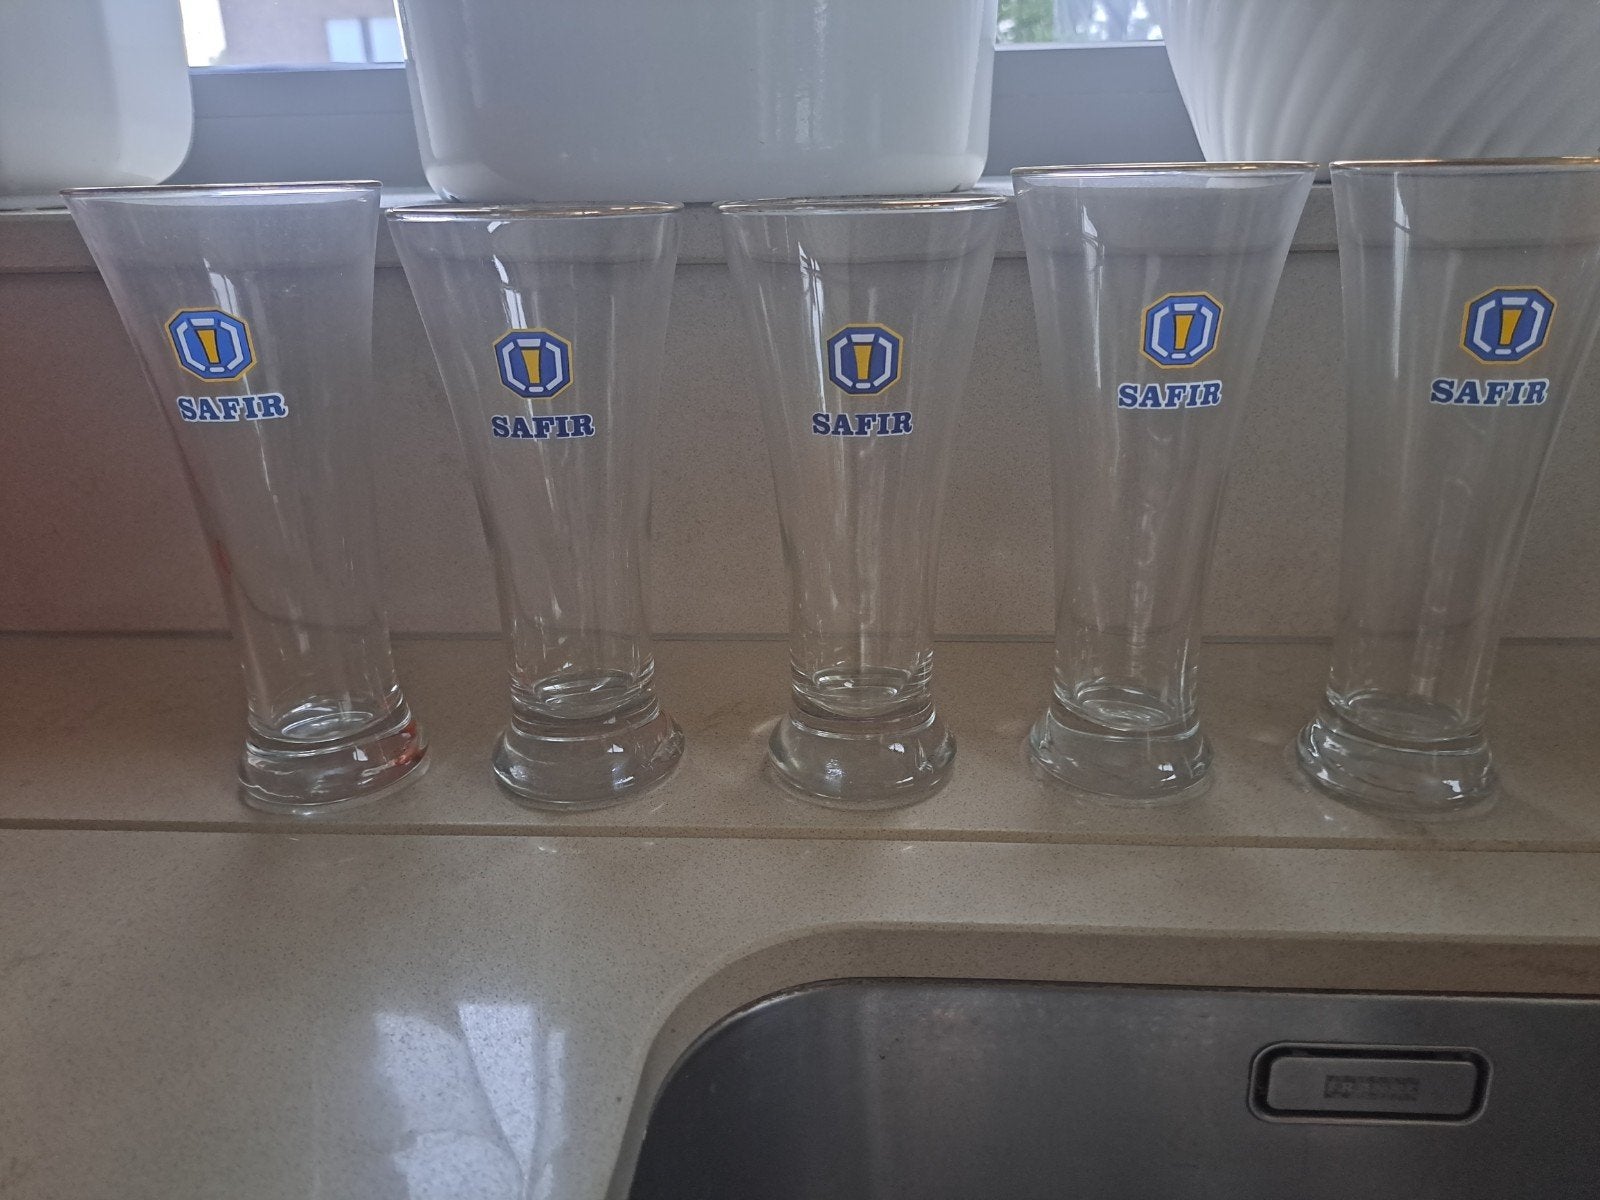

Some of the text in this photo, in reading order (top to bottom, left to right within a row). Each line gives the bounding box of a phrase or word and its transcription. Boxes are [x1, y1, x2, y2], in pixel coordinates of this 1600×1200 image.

[1118, 380, 1222, 409] SAFIR
[1430, 378, 1549, 406] SAFIR
[177, 393, 288, 421] SAFIR
[491, 414, 595, 439] SAFIR
[812, 411, 913, 437] SAFIR
